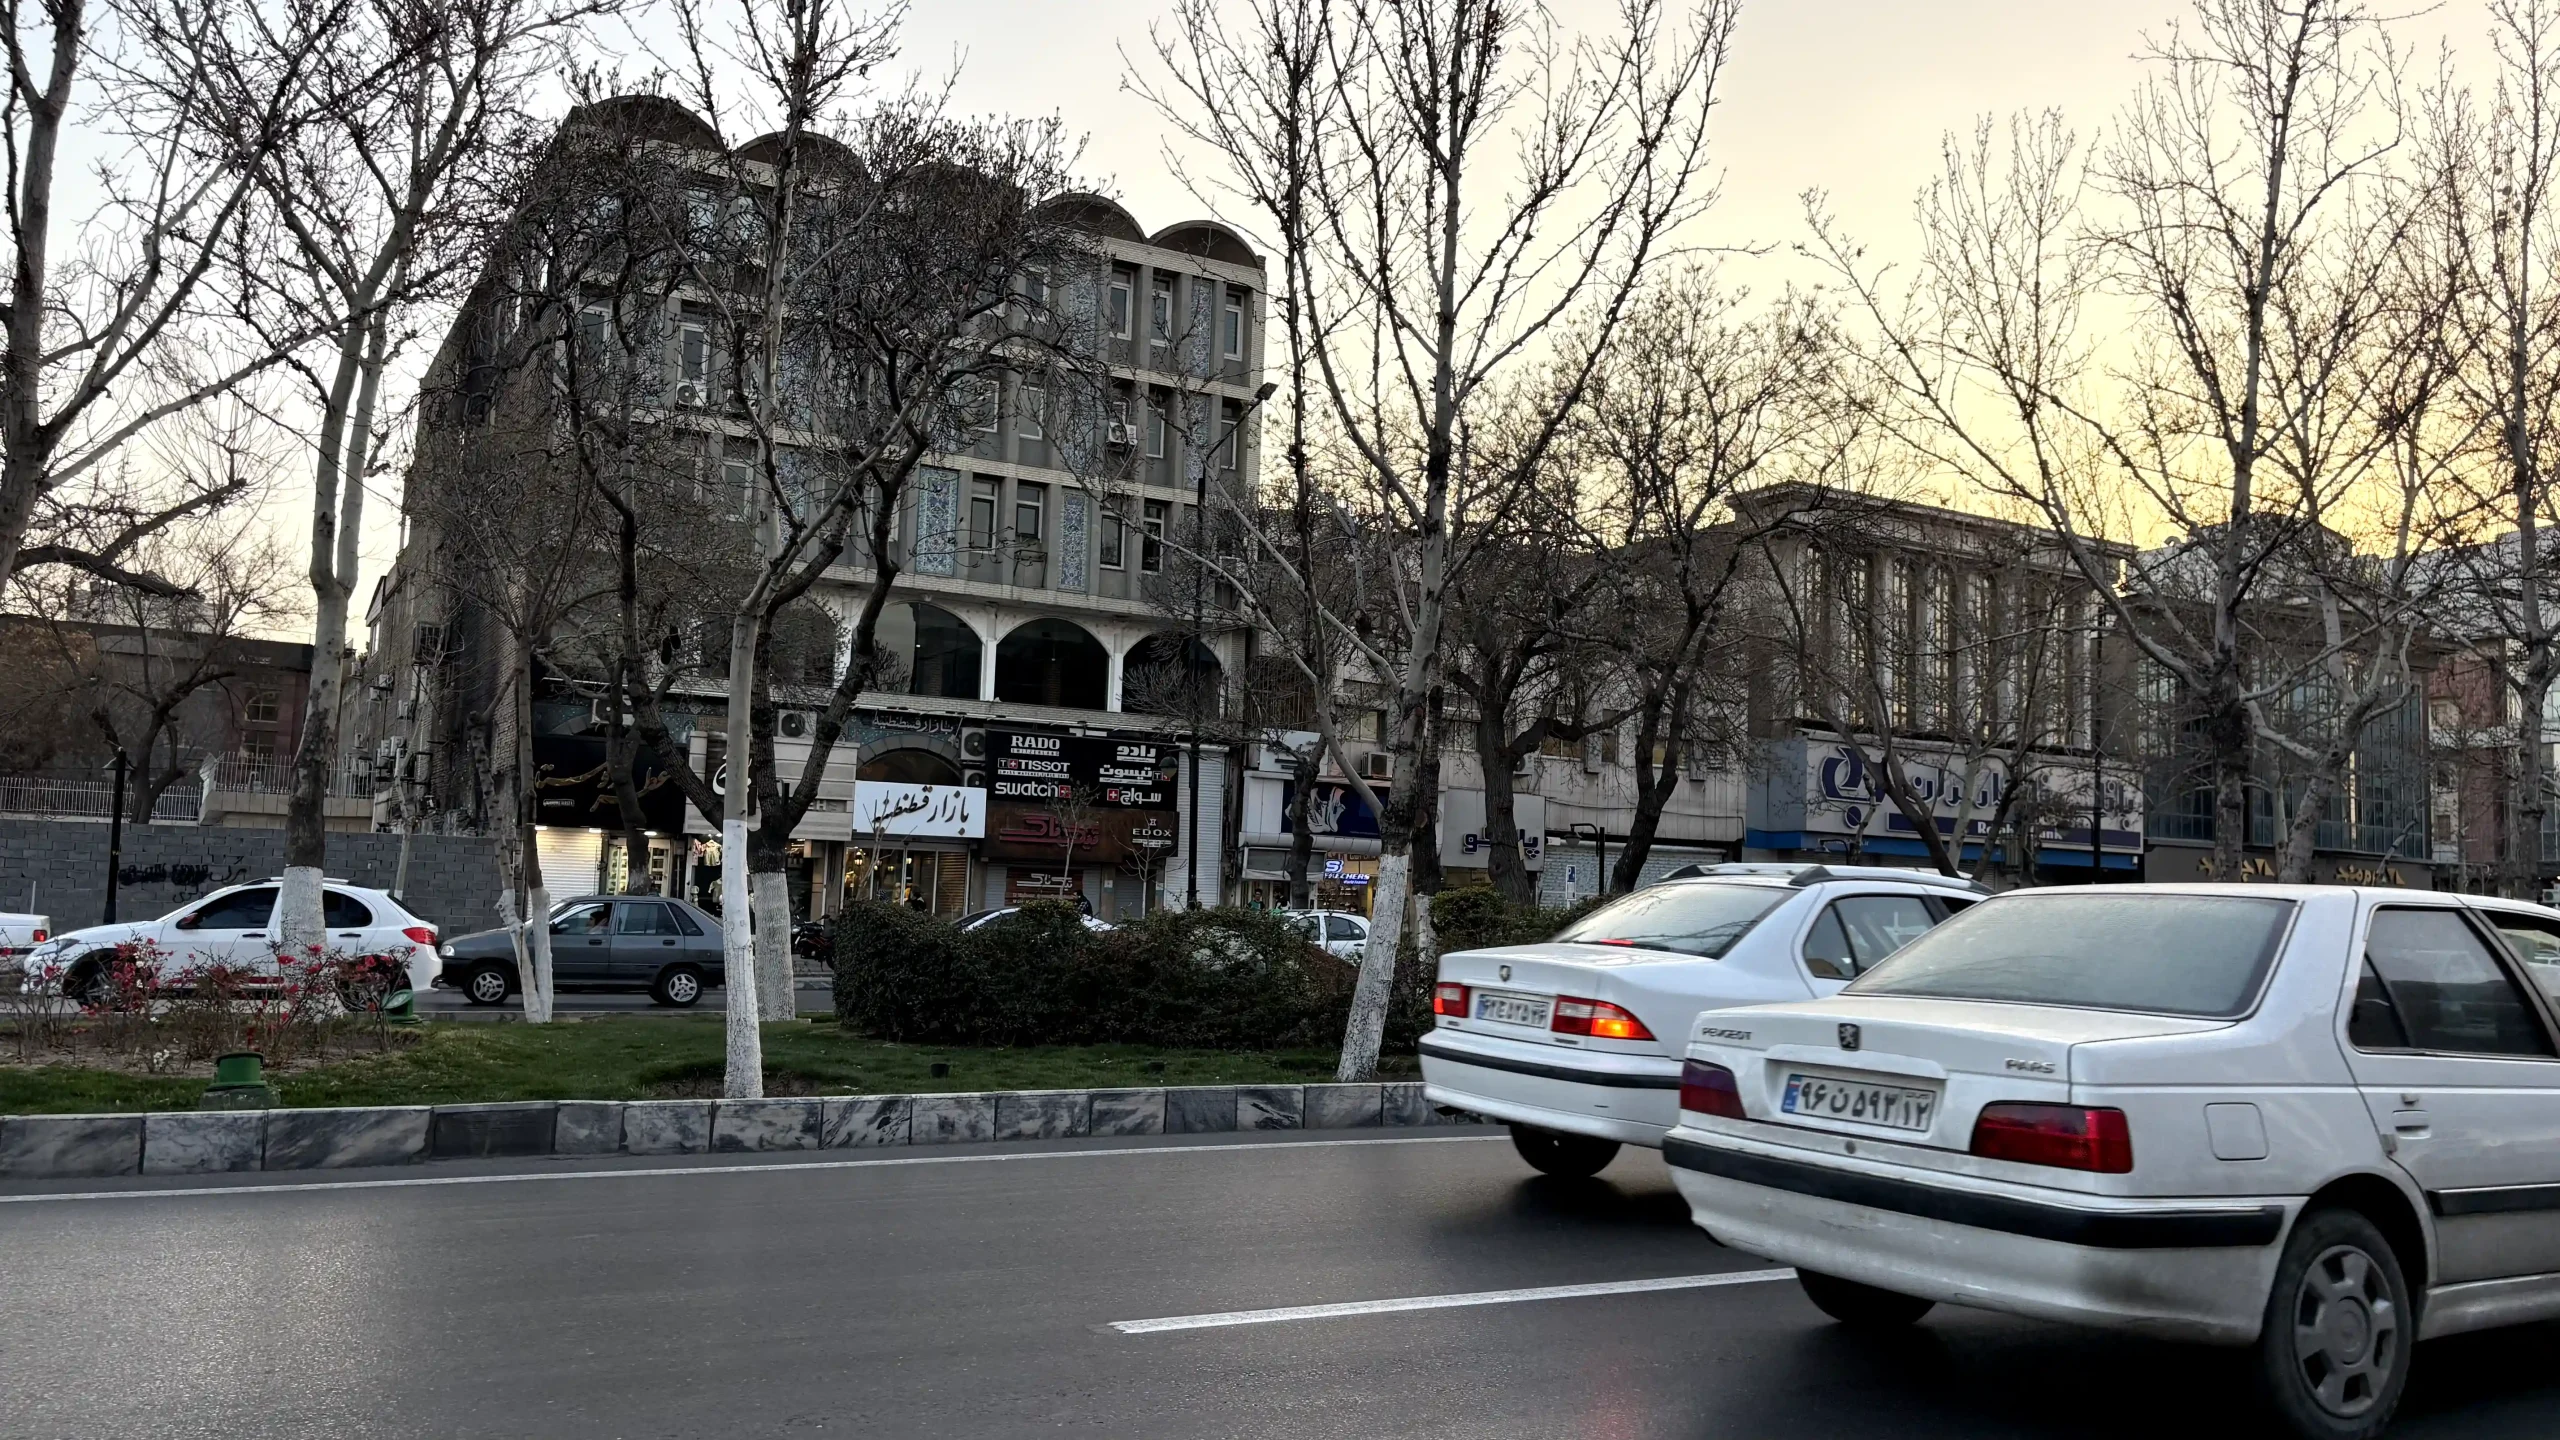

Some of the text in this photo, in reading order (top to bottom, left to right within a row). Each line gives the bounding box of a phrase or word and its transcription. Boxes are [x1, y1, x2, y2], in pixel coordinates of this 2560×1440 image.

[1010, 735, 1060, 750] RADO
[1116, 745, 1156, 758] رادو
[1018, 759, 1071, 772] TISSOT
[1099, 764, 1153, 780] تیسوت
[995, 781, 1059, 797] swatch
[1120, 787, 1162, 805] سواچ
[926, 790, 970, 836] بازار
[1132, 828, 1172, 837] EDOX
[1978, 821, 2015, 835] Rah
[1702, 1027, 1752, 1040] PEUGEOT
[2005, 1057, 2056, 1073] PARS
